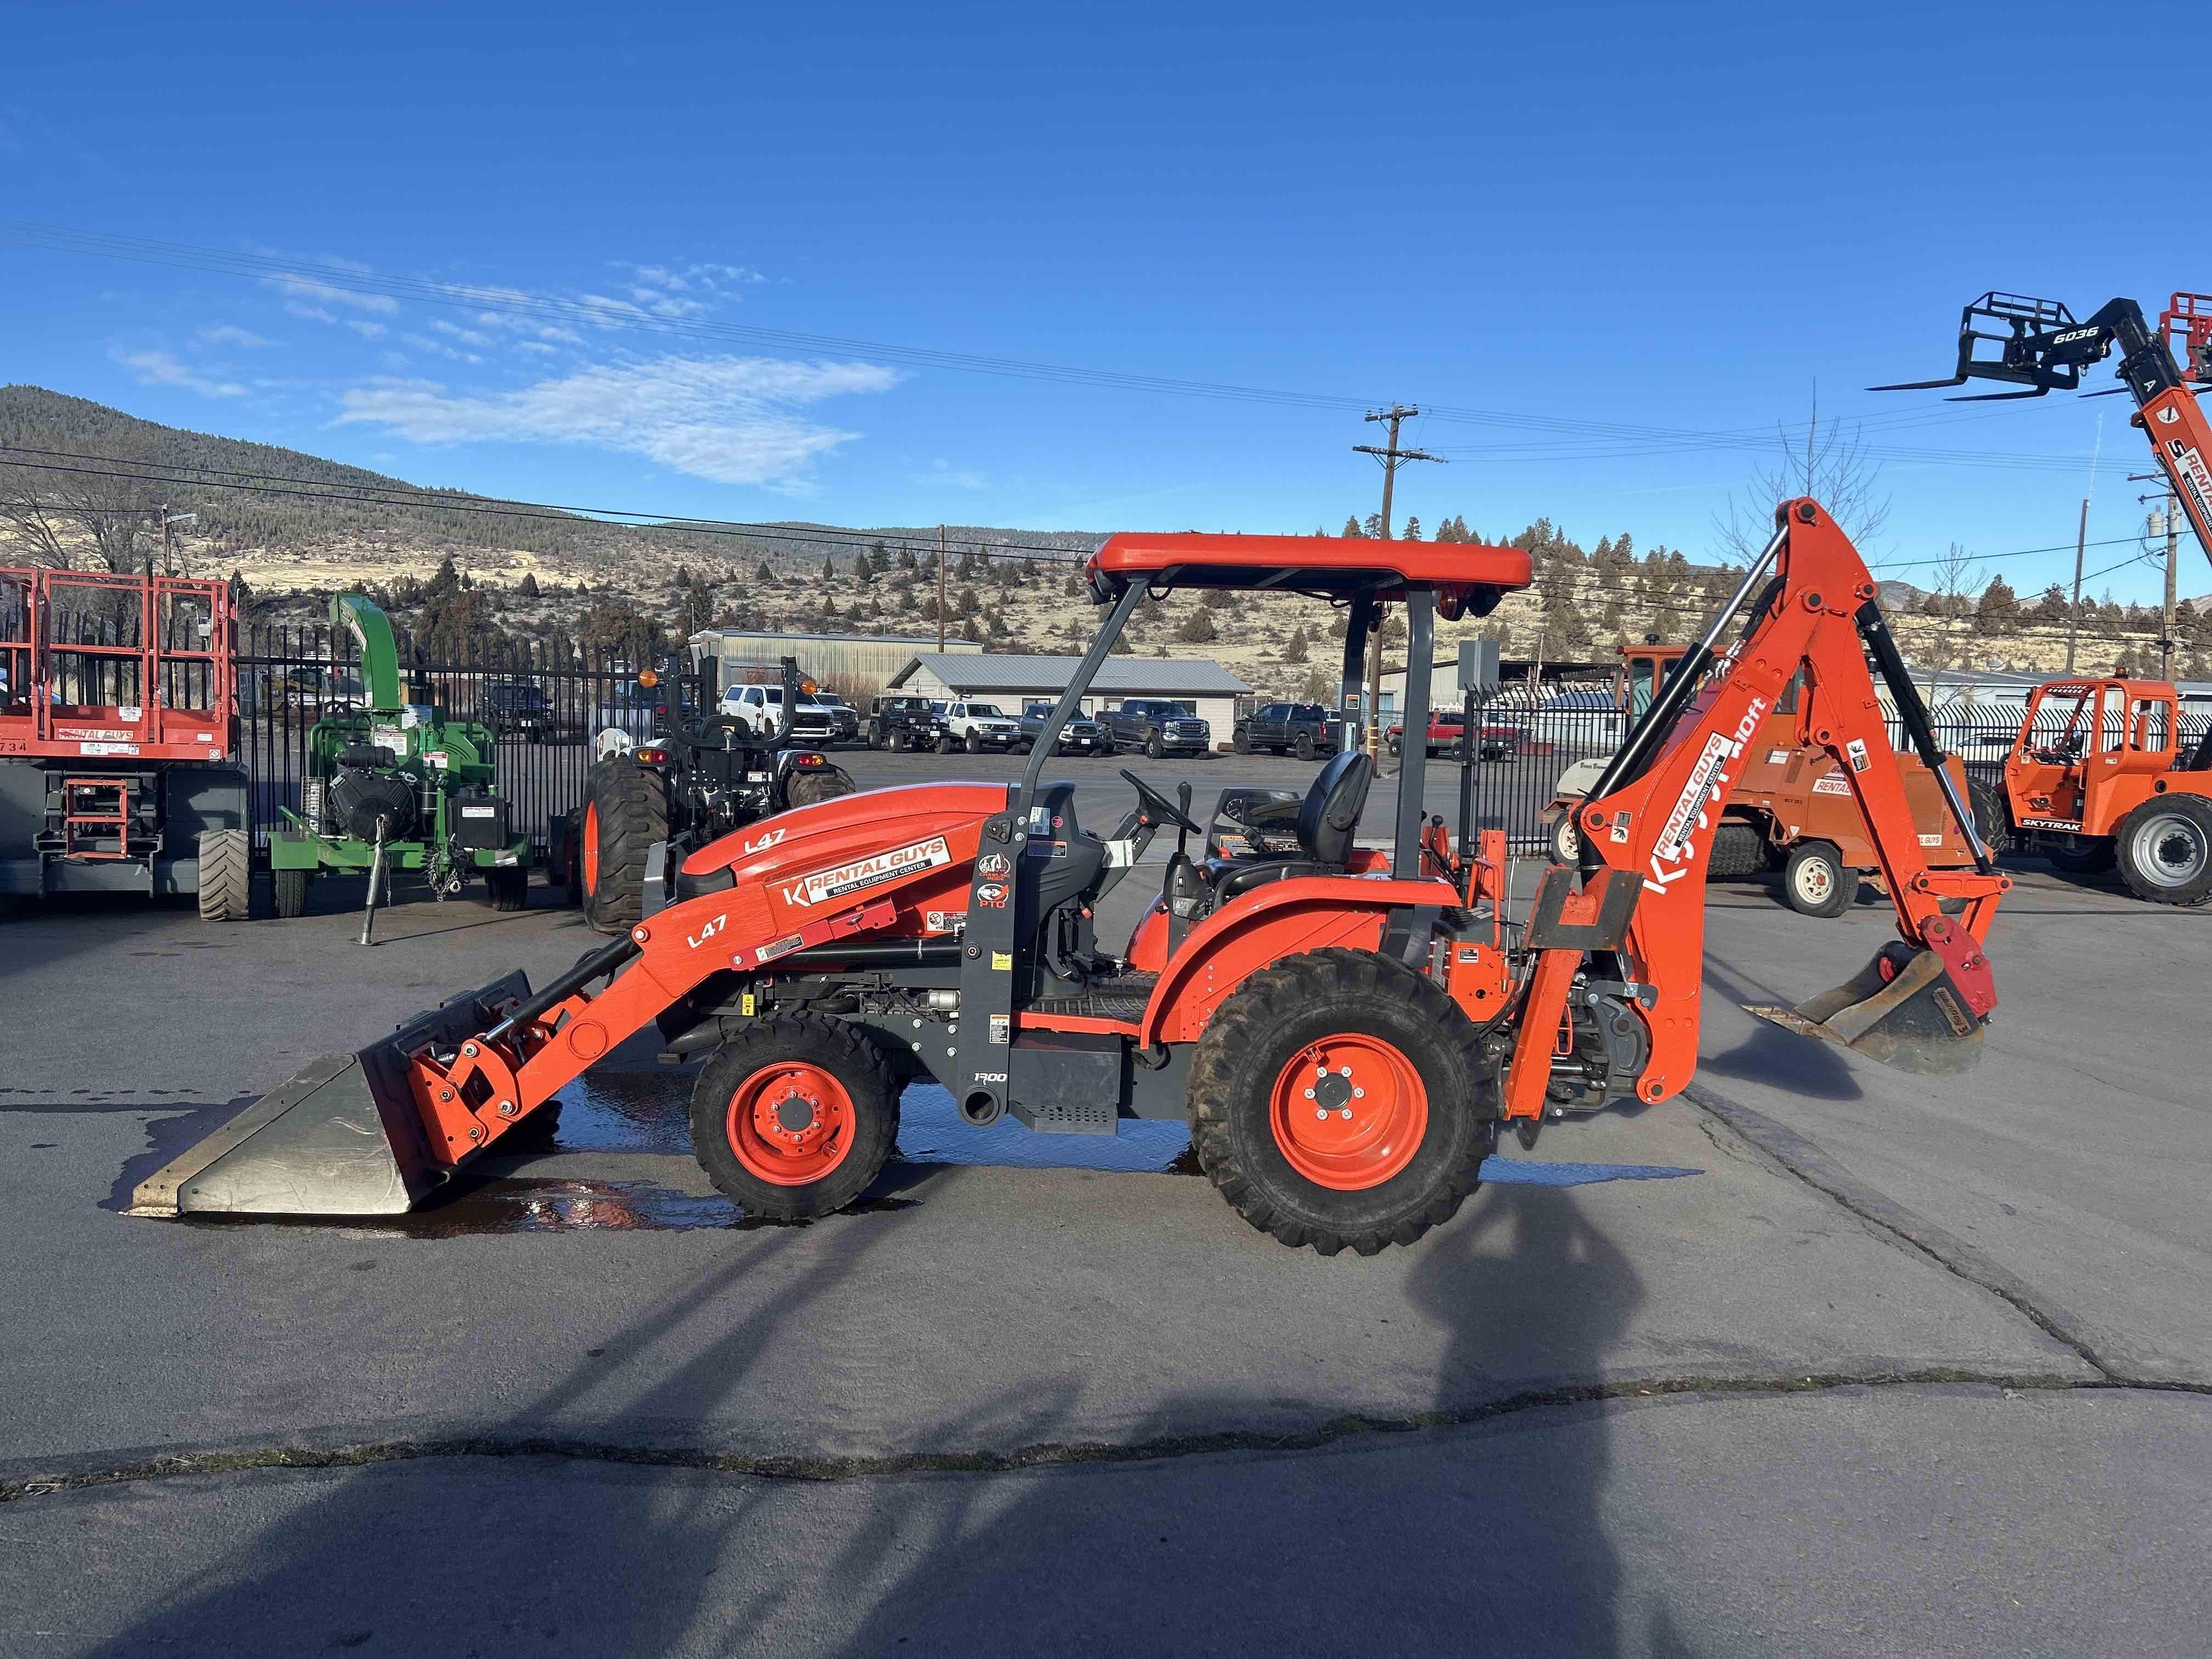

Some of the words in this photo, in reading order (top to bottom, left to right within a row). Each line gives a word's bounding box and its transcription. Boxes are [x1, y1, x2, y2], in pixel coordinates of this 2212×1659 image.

[2054, 327, 2099, 345] 6036
[2143, 379, 2157, 392] A
[2186, 477, 2200, 499] RENTAL
[1657, 787, 1698, 856] RENTAL
[1693, 735, 1723, 788] GUYS
[1817, 781, 1850, 793] RENTAL
[1677, 816, 1697, 843] RENTAL
[1689, 785, 1711, 822] EQUIPMENT
[1705, 760, 1723, 785] CENTER
[2022, 819, 2081, 831] SKYTRAK
[744, 828, 786, 853] L47
[809, 860, 887, 891] RENTAL
[890, 839, 944, 866] GUYS
[833, 881, 859, 895] RENTAL
[860, 870, 899, 887] EQUIPMENT
[899, 861, 926, 874] CENTER
[687, 913, 727, 949] L47
